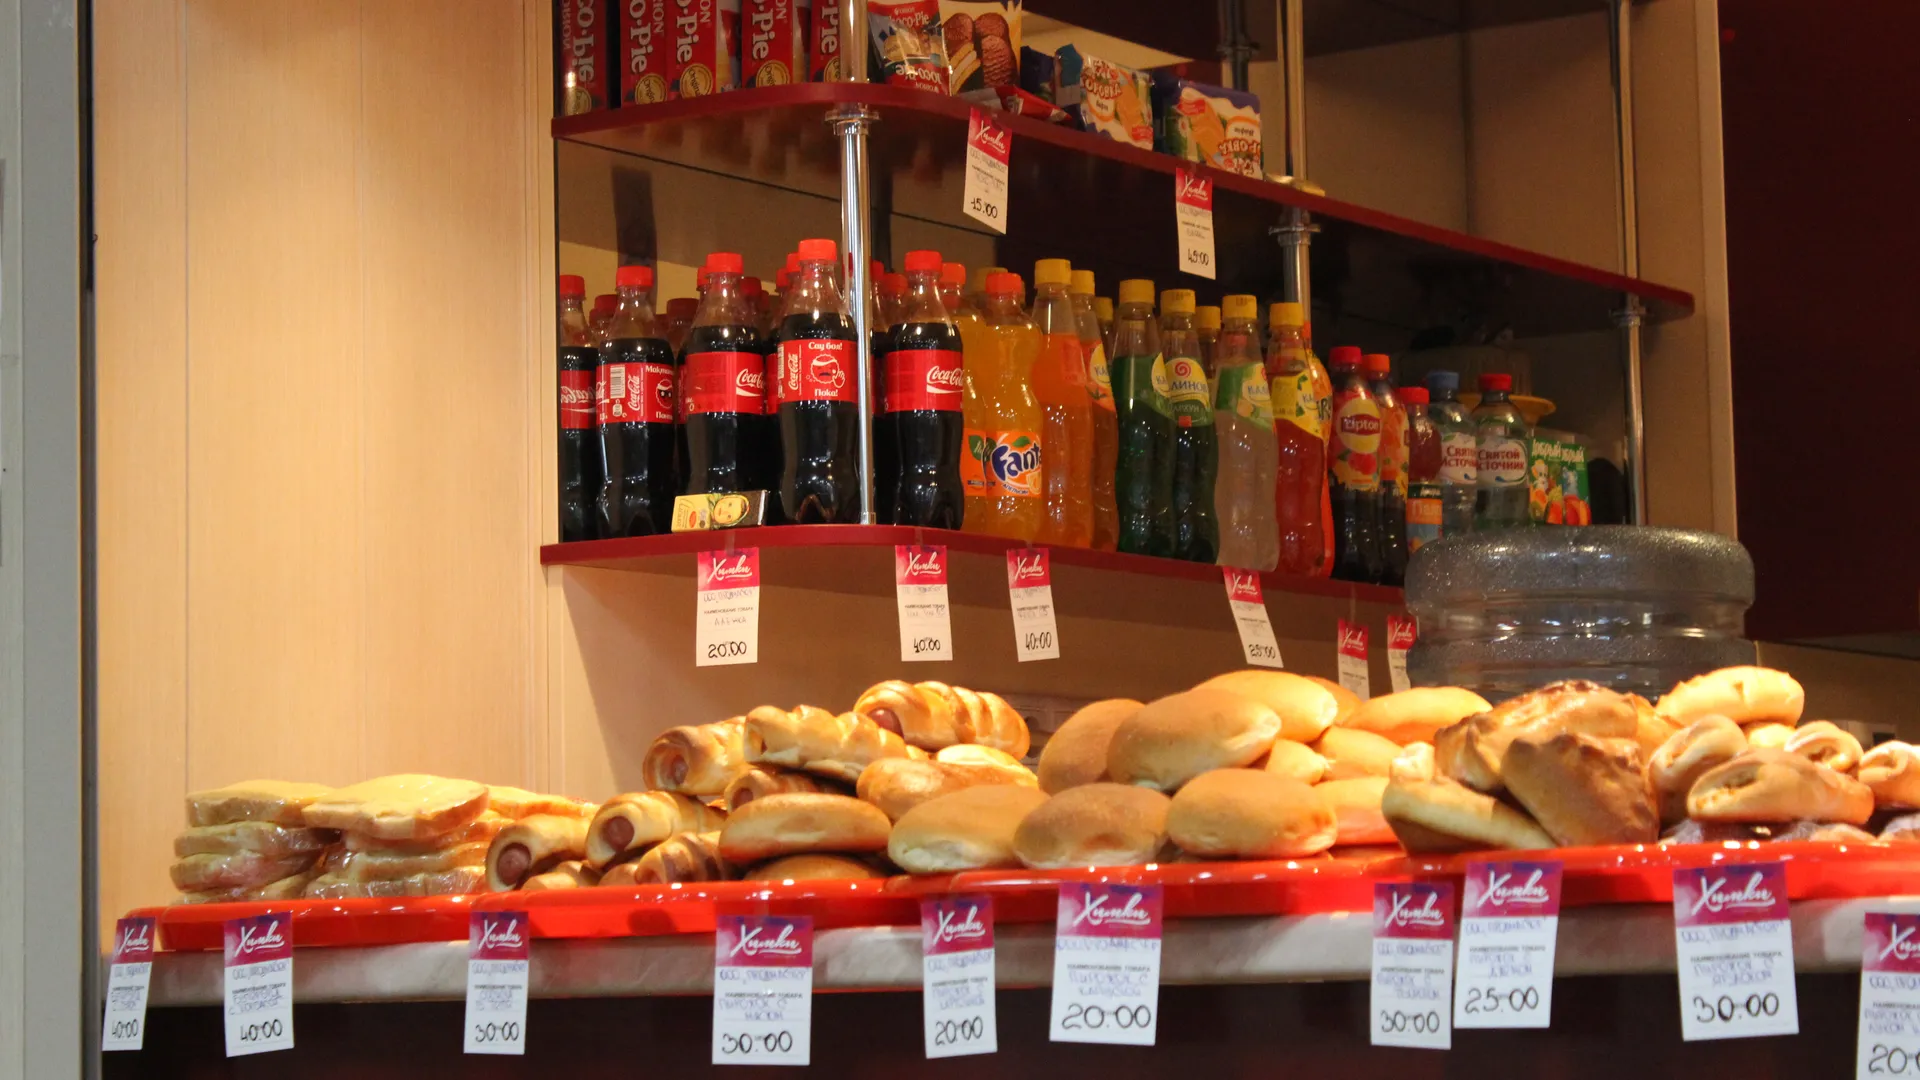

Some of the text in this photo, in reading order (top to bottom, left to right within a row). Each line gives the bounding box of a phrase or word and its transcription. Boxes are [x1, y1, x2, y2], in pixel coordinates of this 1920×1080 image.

[1343, 417, 1379, 433] Lipton
[991, 443, 1042, 482] Fant
[1477, 869, 1549, 908] Химки
[1691, 871, 1776, 916] Химки
[933, 905, 986, 945] Химки
[1072, 892, 1151, 927] Химки
[1384, 891, 1445, 928] Химки
[234, 920, 285, 957] Химки
[479, 919, 522, 950] Химки
[730, 924, 802, 957] Химки
[1464, 986, 1539, 1014] 25.00
[1692, 992, 1779, 1024] 30.00
[240, 1019, 283, 1041] 40.00
[475, 1022, 519, 1042] 30.00
[935, 1016, 984, 1046] 20.00
[1062, 1003, 1151, 1030] 20.00
[1381, 1010, 1440, 1033] 30.00
[721, 1030, 793, 1054] 30.00
